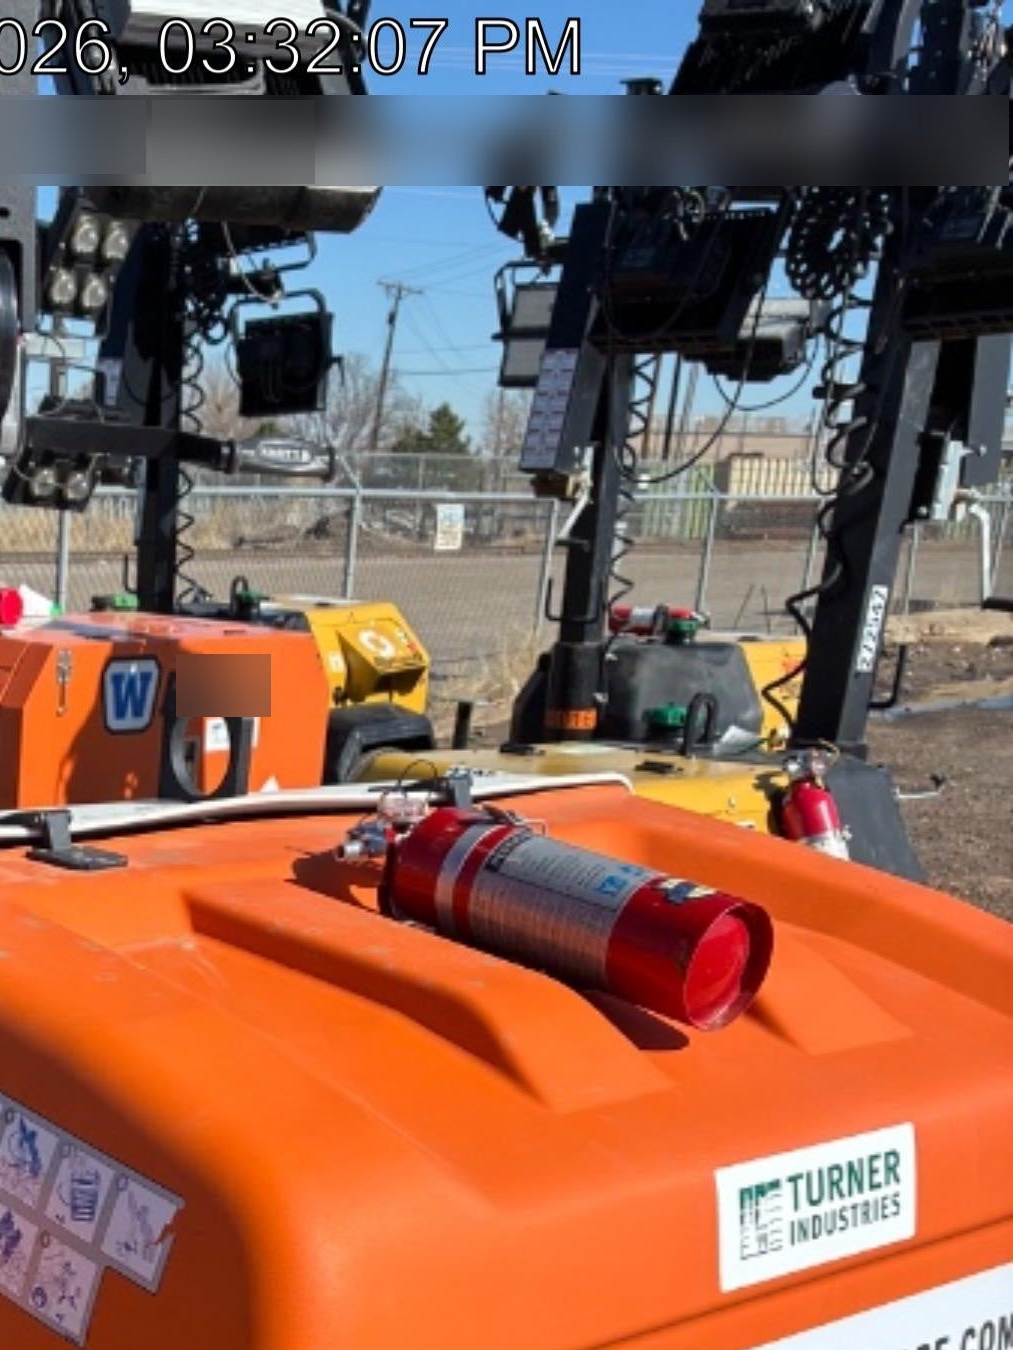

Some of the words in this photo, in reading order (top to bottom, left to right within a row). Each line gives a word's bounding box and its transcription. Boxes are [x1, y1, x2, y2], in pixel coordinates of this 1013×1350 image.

[110, 670, 154, 721] W
[787, 1149, 902, 1212] TURNER
[789, 1191, 902, 1246] INDUSTRIES
